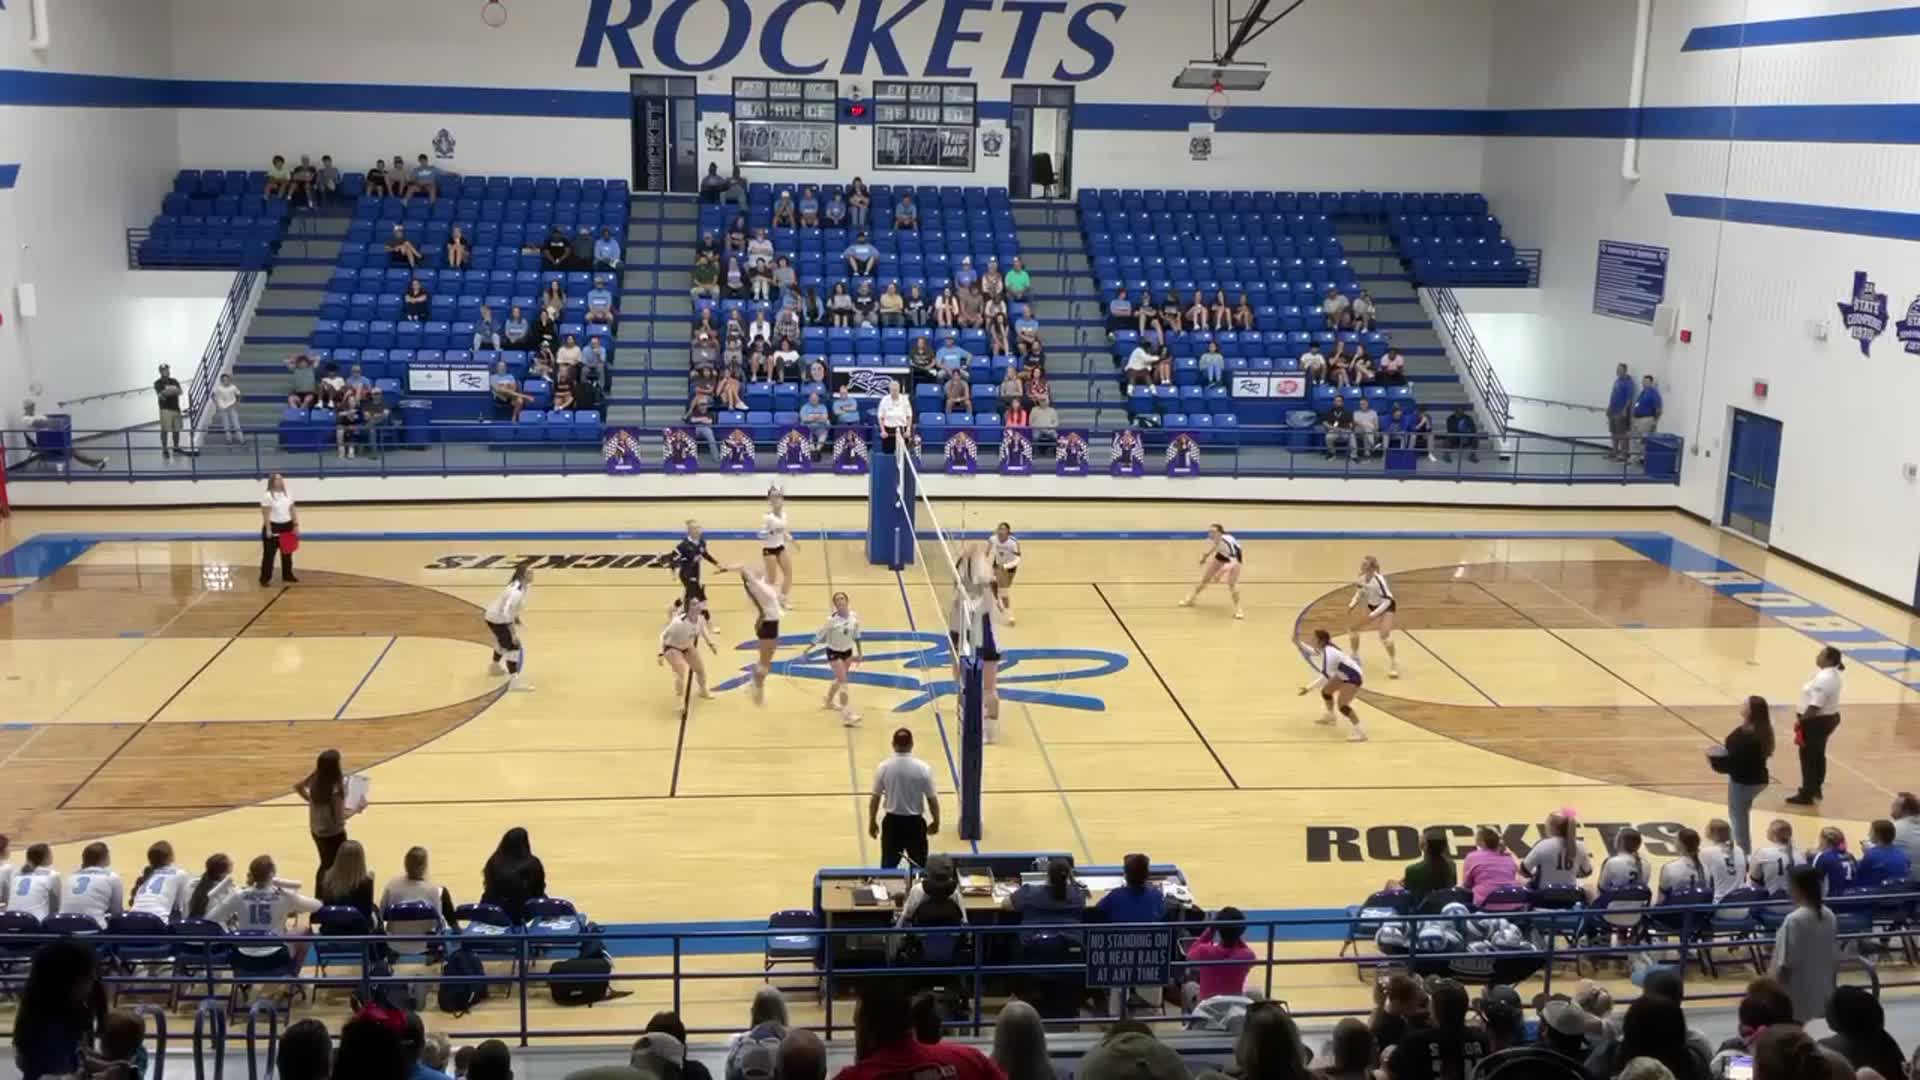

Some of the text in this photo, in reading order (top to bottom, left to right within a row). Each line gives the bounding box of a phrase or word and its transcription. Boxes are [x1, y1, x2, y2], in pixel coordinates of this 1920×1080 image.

[575, 0, 1127, 82] ROCKETS
[941, 145, 967, 157] DAY
[1090, 932, 1168, 949] NO STANDING ON
[1091, 949, 1167, 966] OR NEAR RAILS
[1097, 966, 1161, 982] AT ANY TIME
